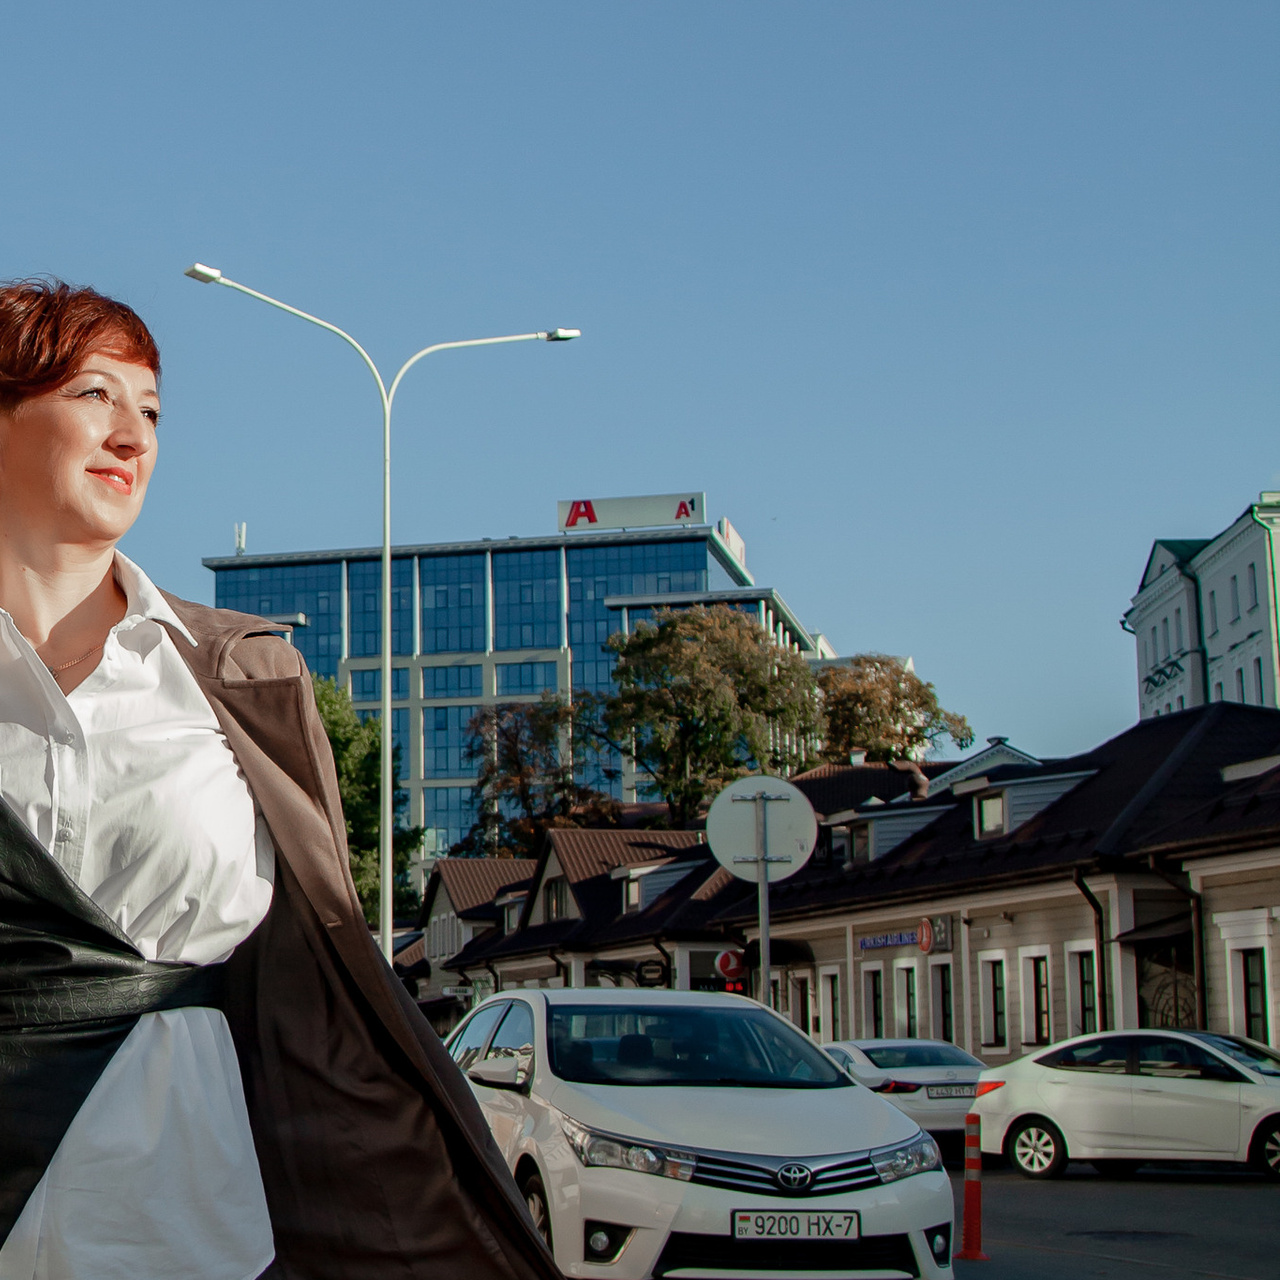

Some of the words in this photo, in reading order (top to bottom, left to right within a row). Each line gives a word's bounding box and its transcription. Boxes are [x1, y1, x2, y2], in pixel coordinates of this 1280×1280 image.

[738, 1226, 749, 1236] BY
[754, 1215, 800, 1236] 9200
[806, 1215, 854, 1236] HX-7
